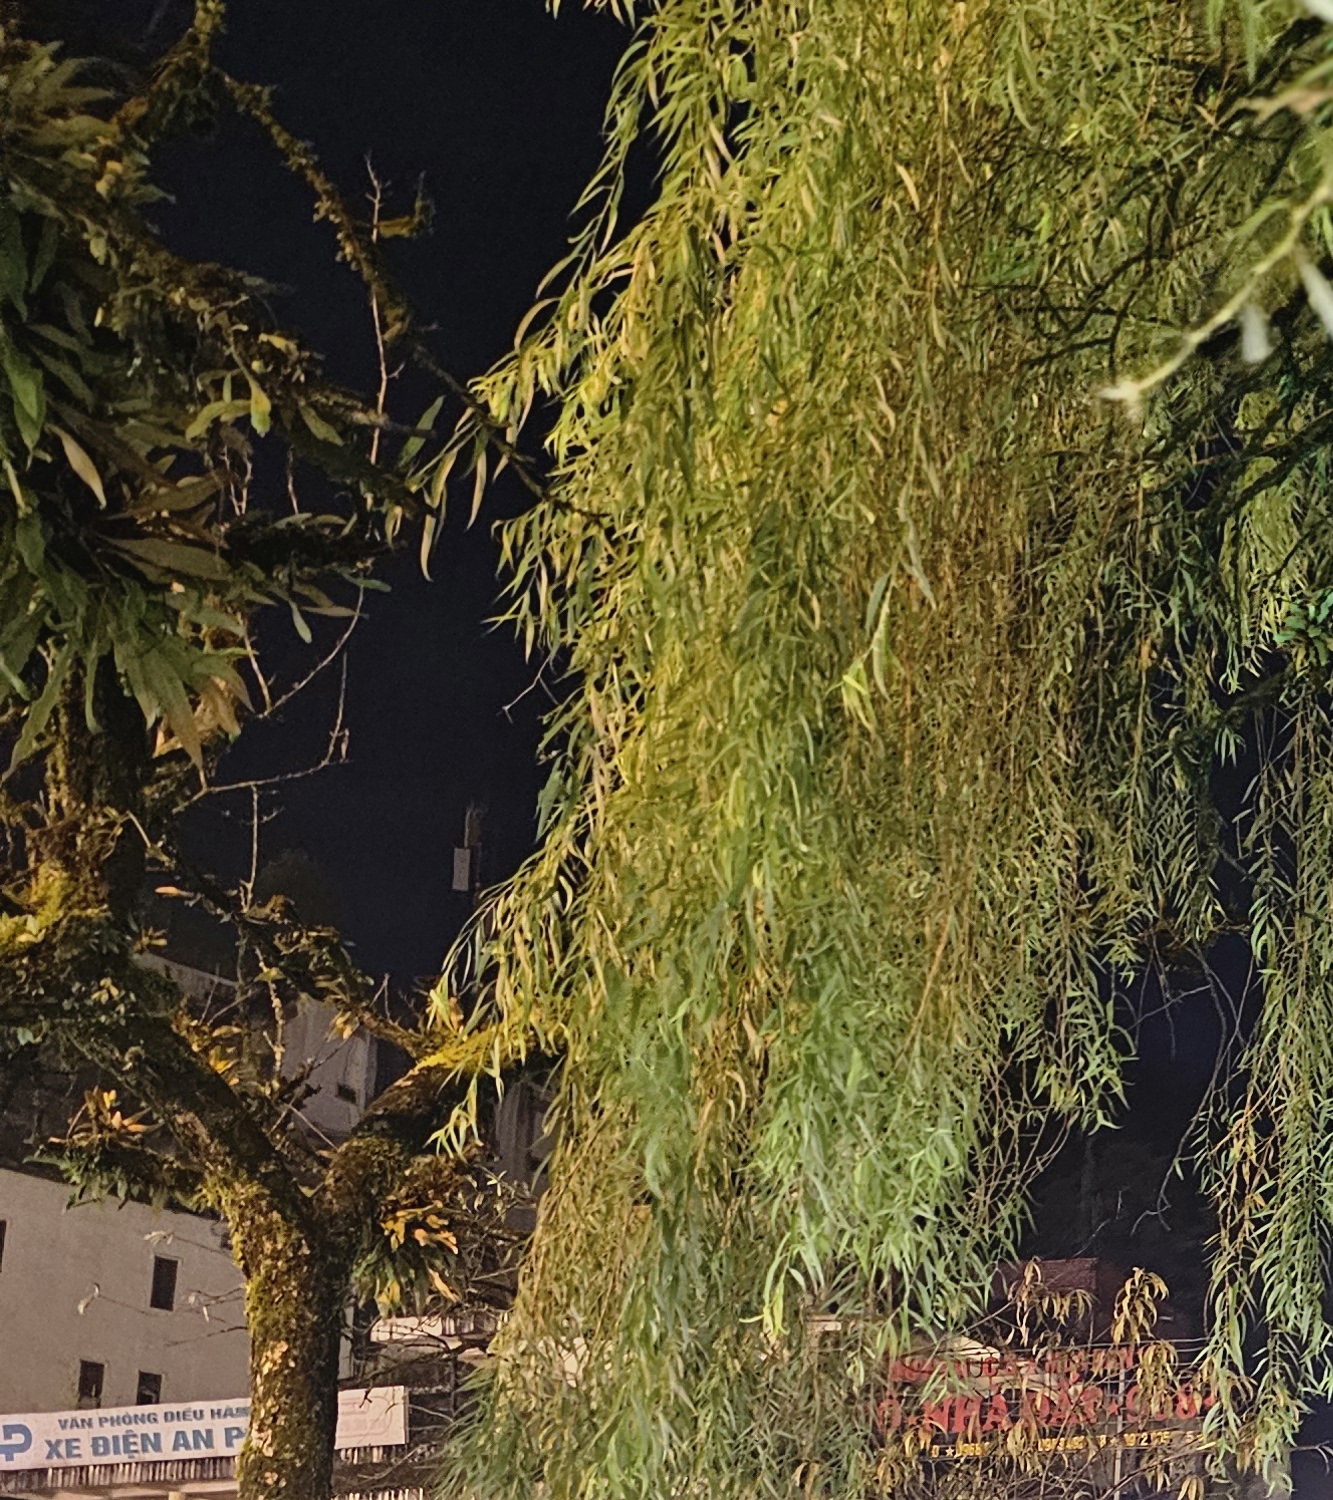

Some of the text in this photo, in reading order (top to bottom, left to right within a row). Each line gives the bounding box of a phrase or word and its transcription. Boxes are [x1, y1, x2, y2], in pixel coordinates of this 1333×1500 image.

[98, 1409, 159, 1428] PHÒNG
[44, 1437, 83, 1460] XE
[90, 1429, 163, 1459] ĐIỆN
[172, 1428, 214, 1451] AN
